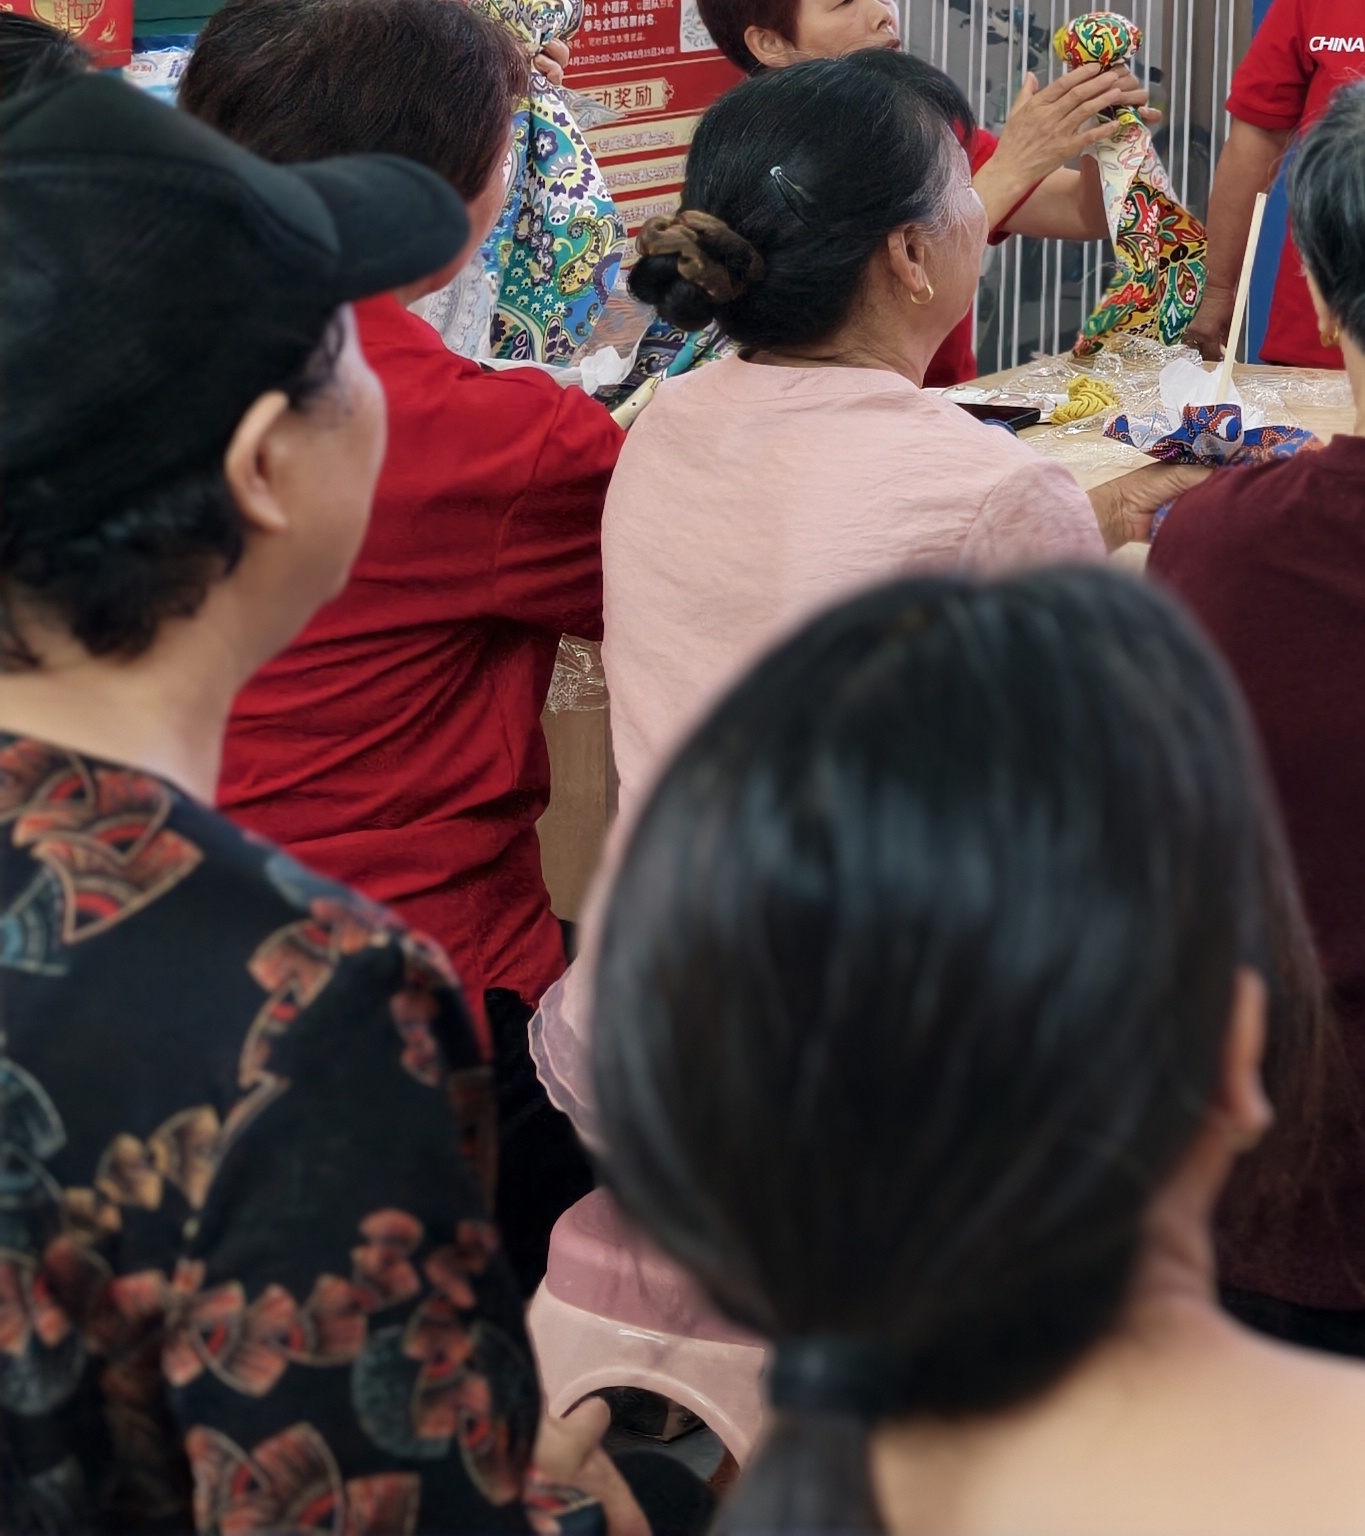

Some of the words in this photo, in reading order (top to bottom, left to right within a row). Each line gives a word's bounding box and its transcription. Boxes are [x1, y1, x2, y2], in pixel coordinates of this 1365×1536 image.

[1308, 35, 1365, 54] CHINA
[584, 84, 652, 111] 动奖励
